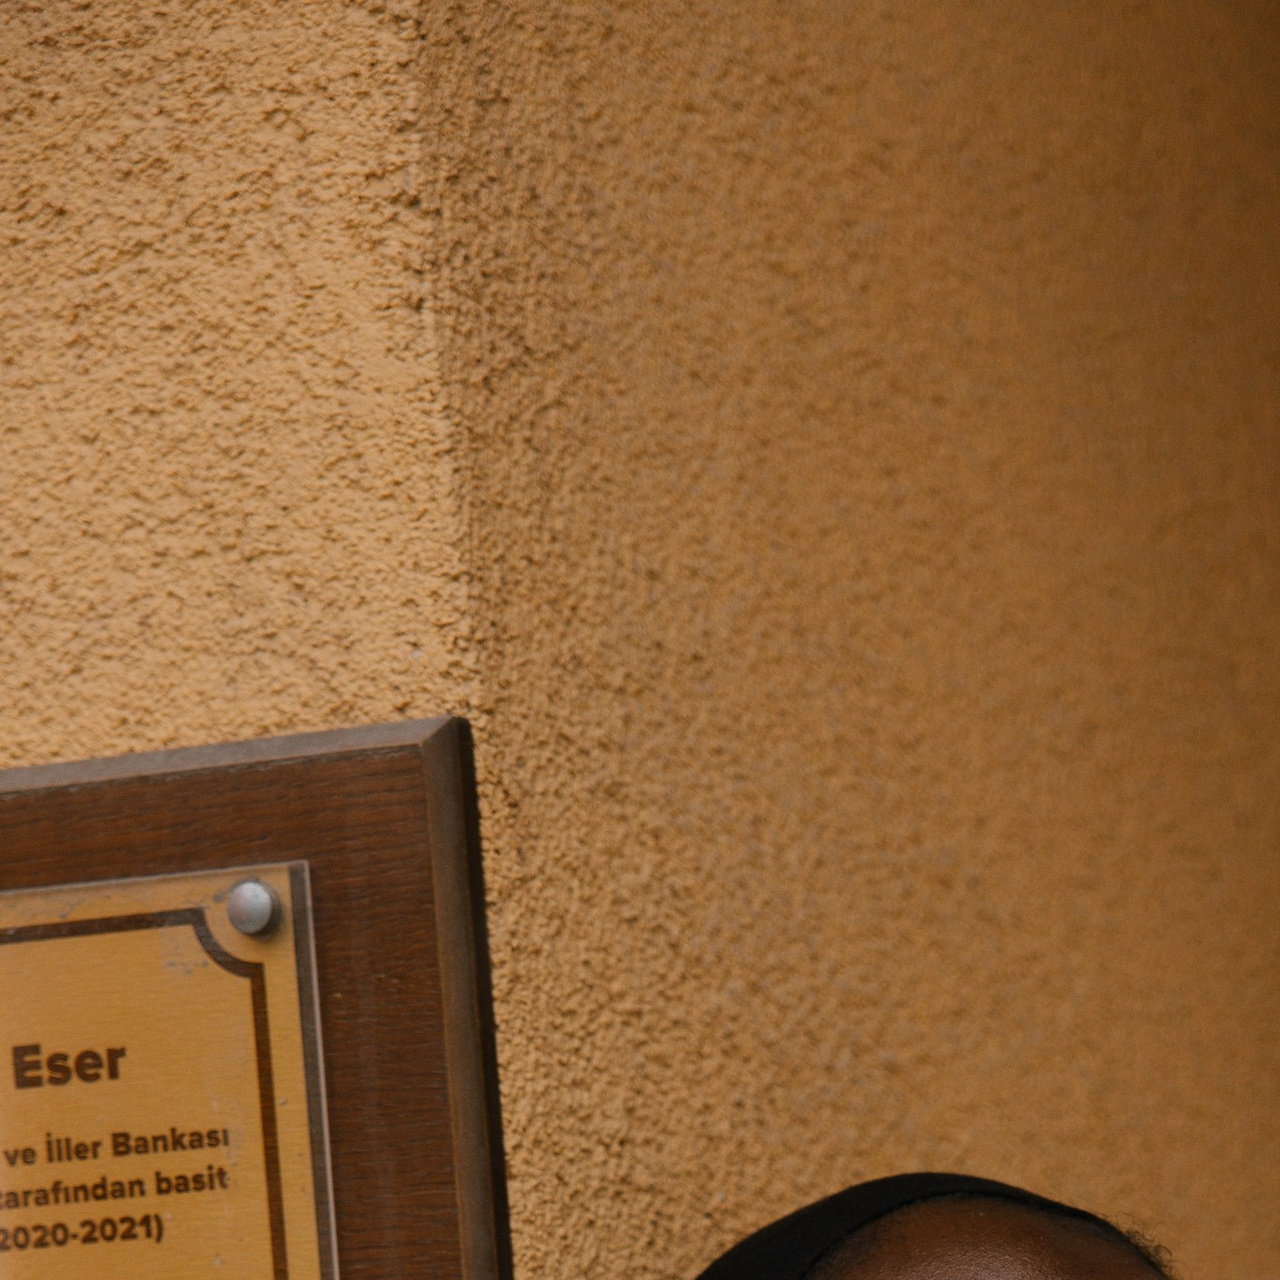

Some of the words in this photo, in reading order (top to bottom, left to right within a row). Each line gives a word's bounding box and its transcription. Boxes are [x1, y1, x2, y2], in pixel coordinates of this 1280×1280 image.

[12, 1043, 127, 1090] Eser
[4, 1146, 37, 1167] ve
[45, 1132, 103, 1163] İller
[111, 1127, 229, 1157] Bankası
[155, 1165, 229, 1195] basit
